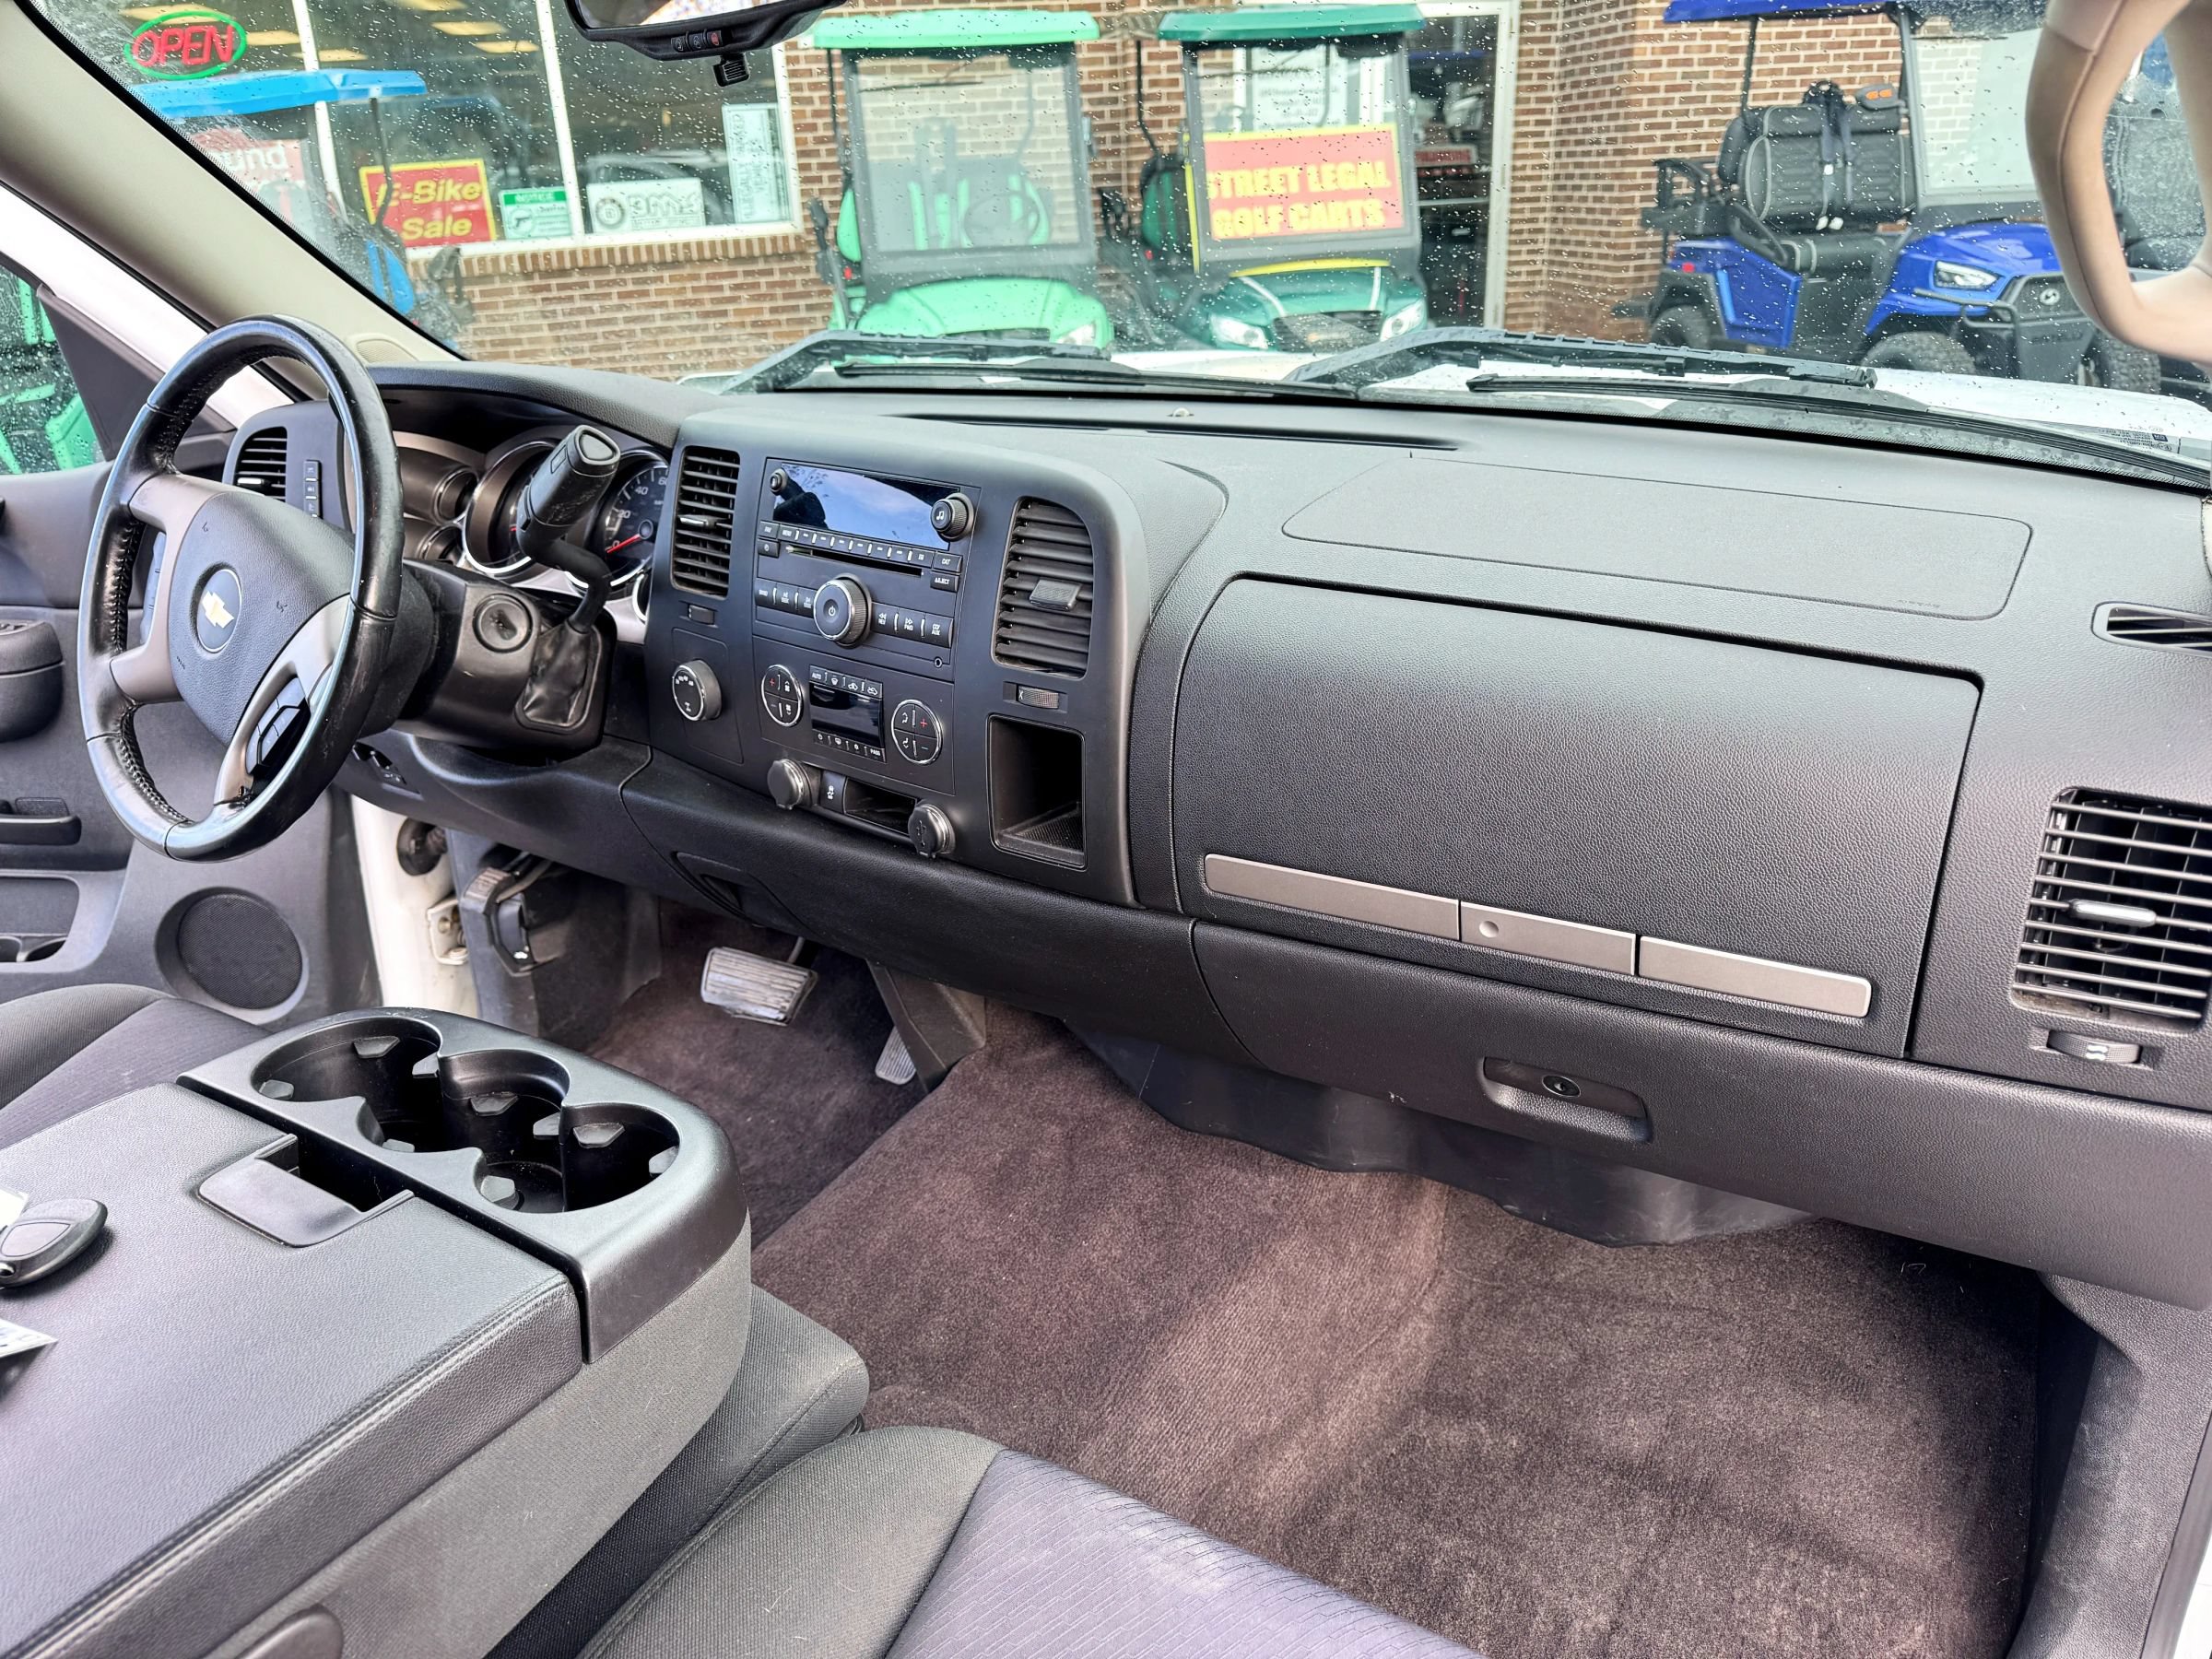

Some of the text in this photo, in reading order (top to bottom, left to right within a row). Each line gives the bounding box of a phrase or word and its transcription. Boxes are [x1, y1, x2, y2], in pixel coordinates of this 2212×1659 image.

[132, 24, 234, 67] OPEN
[376, 178, 482, 207] E-Bike
[1206, 160, 1392, 199] STREET LEGAL
[401, 214, 472, 240] Sale
[1213, 197, 1384, 238] GOLF CARTS
[634, 485, 649, 496] 40
[618, 510, 631, 519] 20
